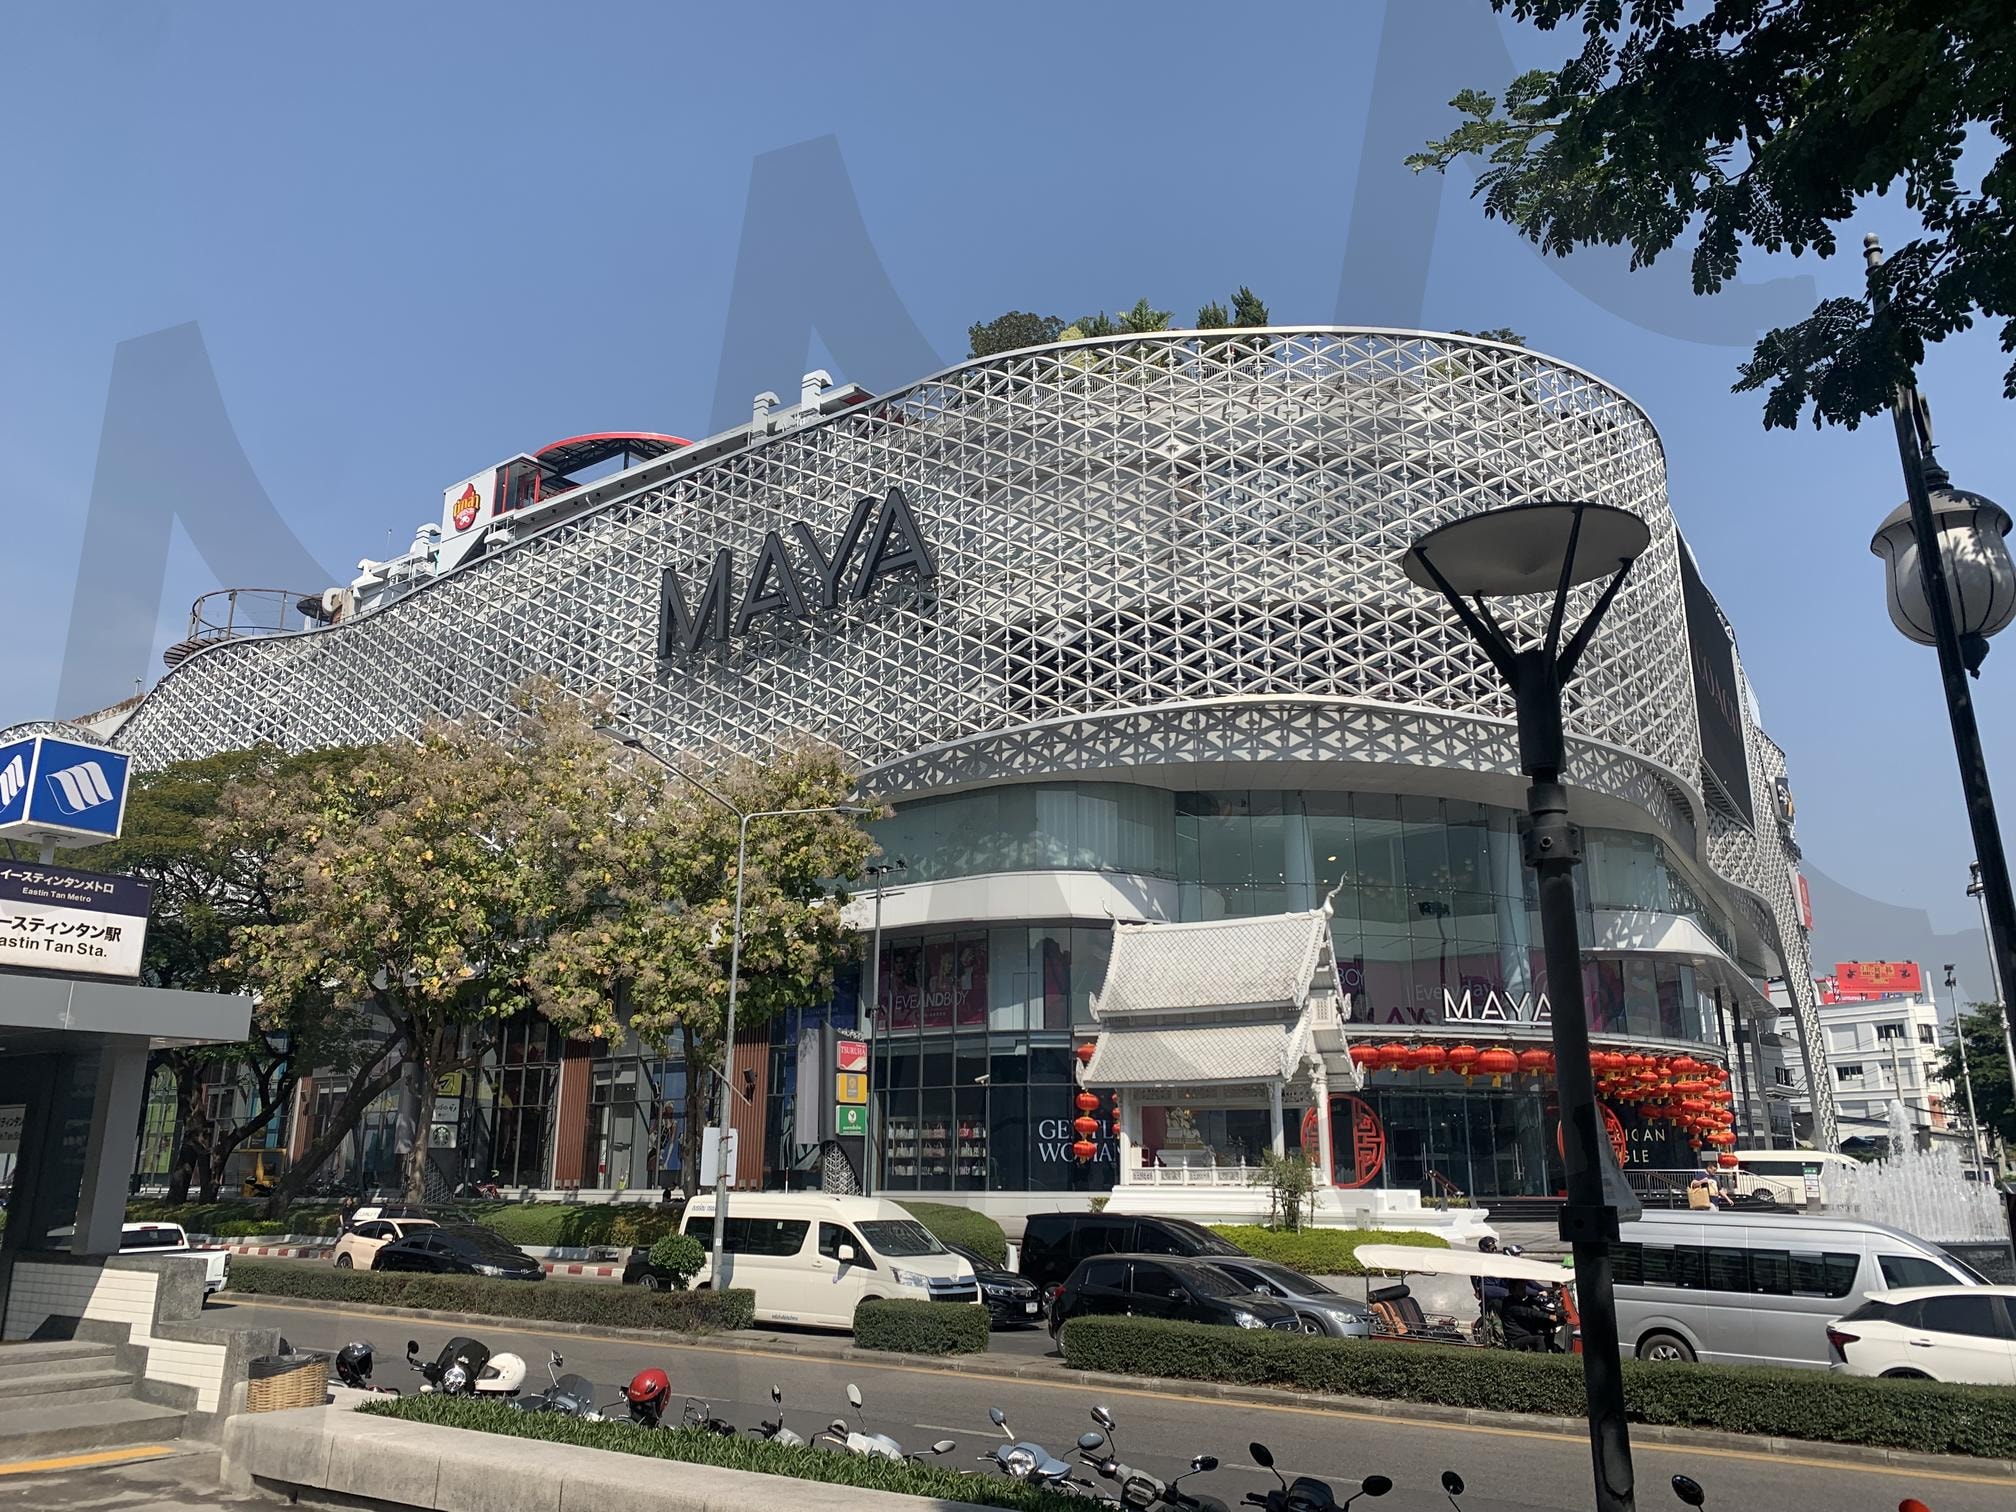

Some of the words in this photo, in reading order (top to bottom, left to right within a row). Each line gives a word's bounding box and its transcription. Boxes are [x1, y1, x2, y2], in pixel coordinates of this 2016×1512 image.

[658, 486, 939, 659] MAYA
[0, 868, 114, 894] イースティンタンメトロ
[22, 887, 49, 897] Eastin
[51, 891, 66, 899] Tan
[67, 893, 92, 903] Metro
[43, 938, 73, 954] Tan
[76, 943, 107, 958] Sta.
[1443, 988, 1552, 1022] MAYA
